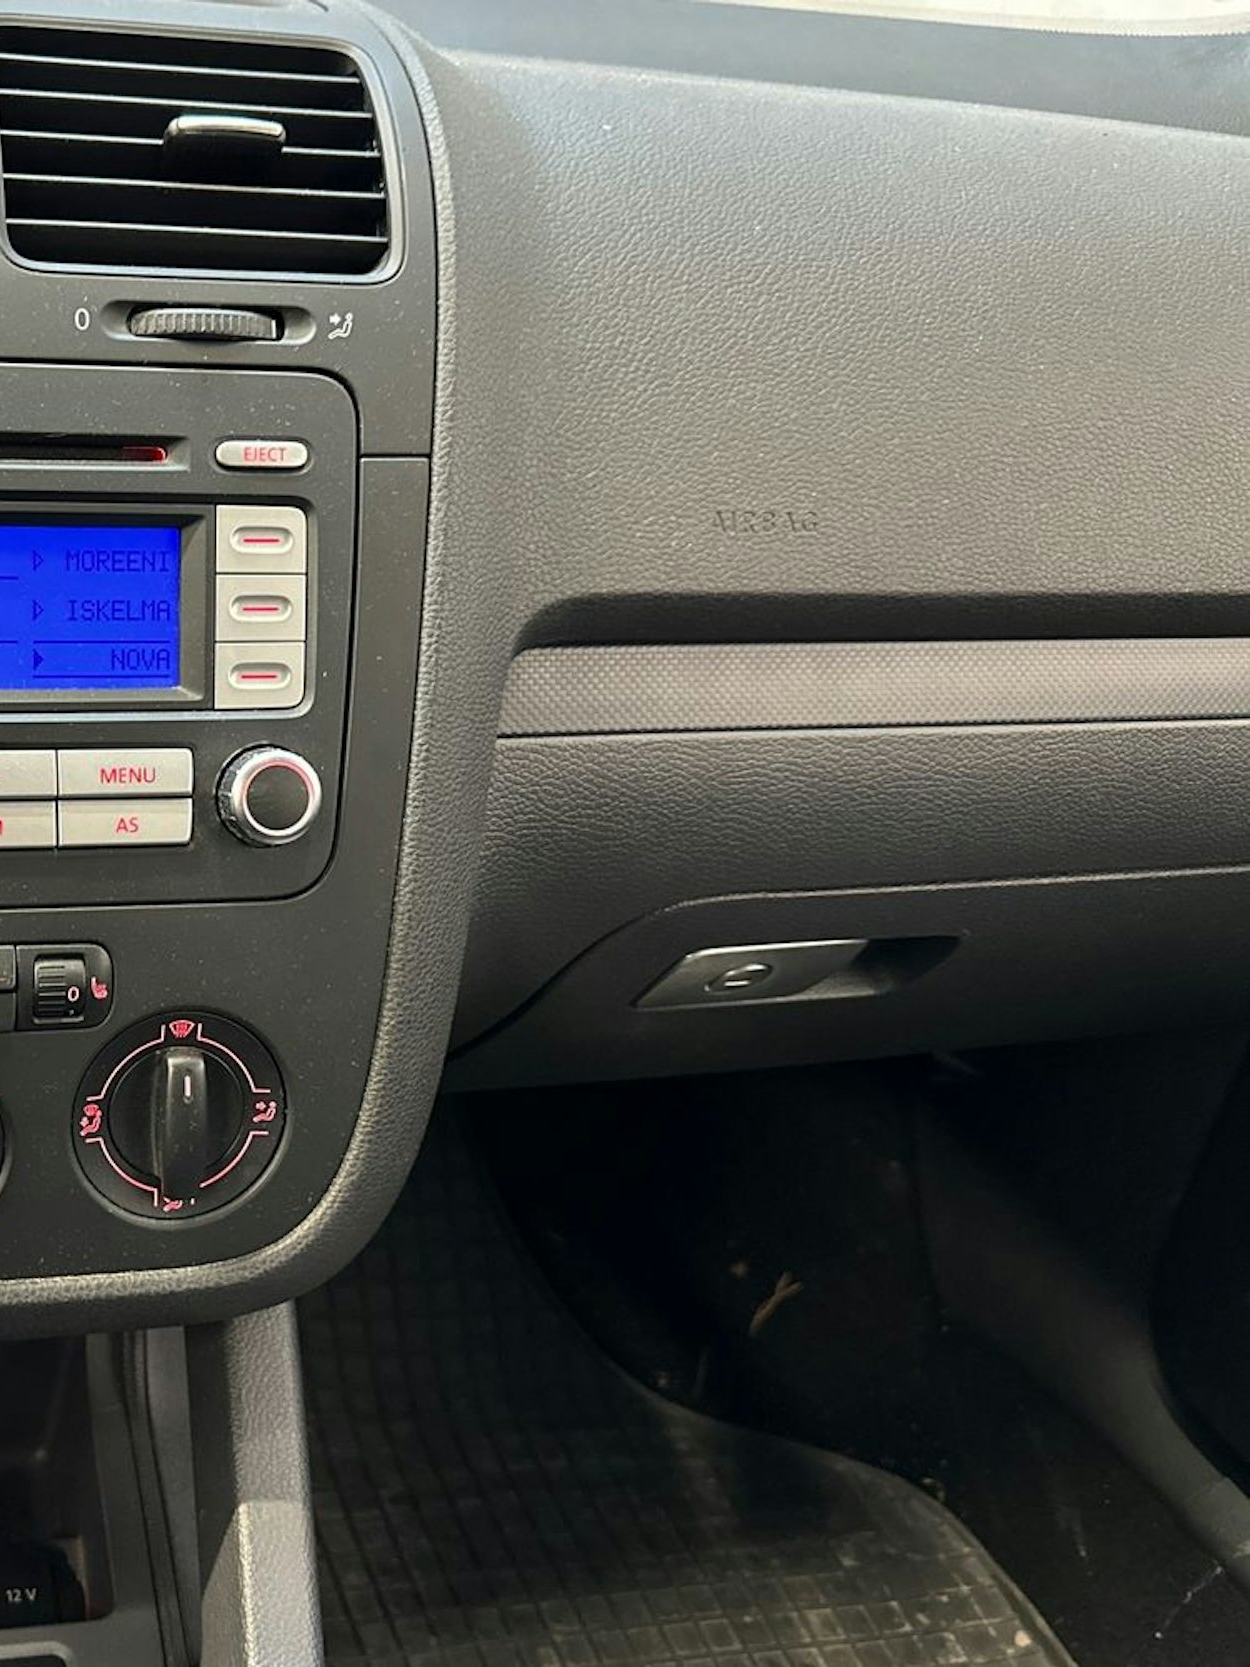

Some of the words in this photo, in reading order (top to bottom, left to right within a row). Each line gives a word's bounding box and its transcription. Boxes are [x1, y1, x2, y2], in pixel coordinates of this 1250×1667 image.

[243, 447, 287, 462] EJECT
[65, 550, 171, 572] MOREENI
[67, 600, 171, 622] ISKELMA
[110, 649, 171, 671] NOVA
[100, 767, 156, 785] MENU
[116, 817, 139, 833] AS
